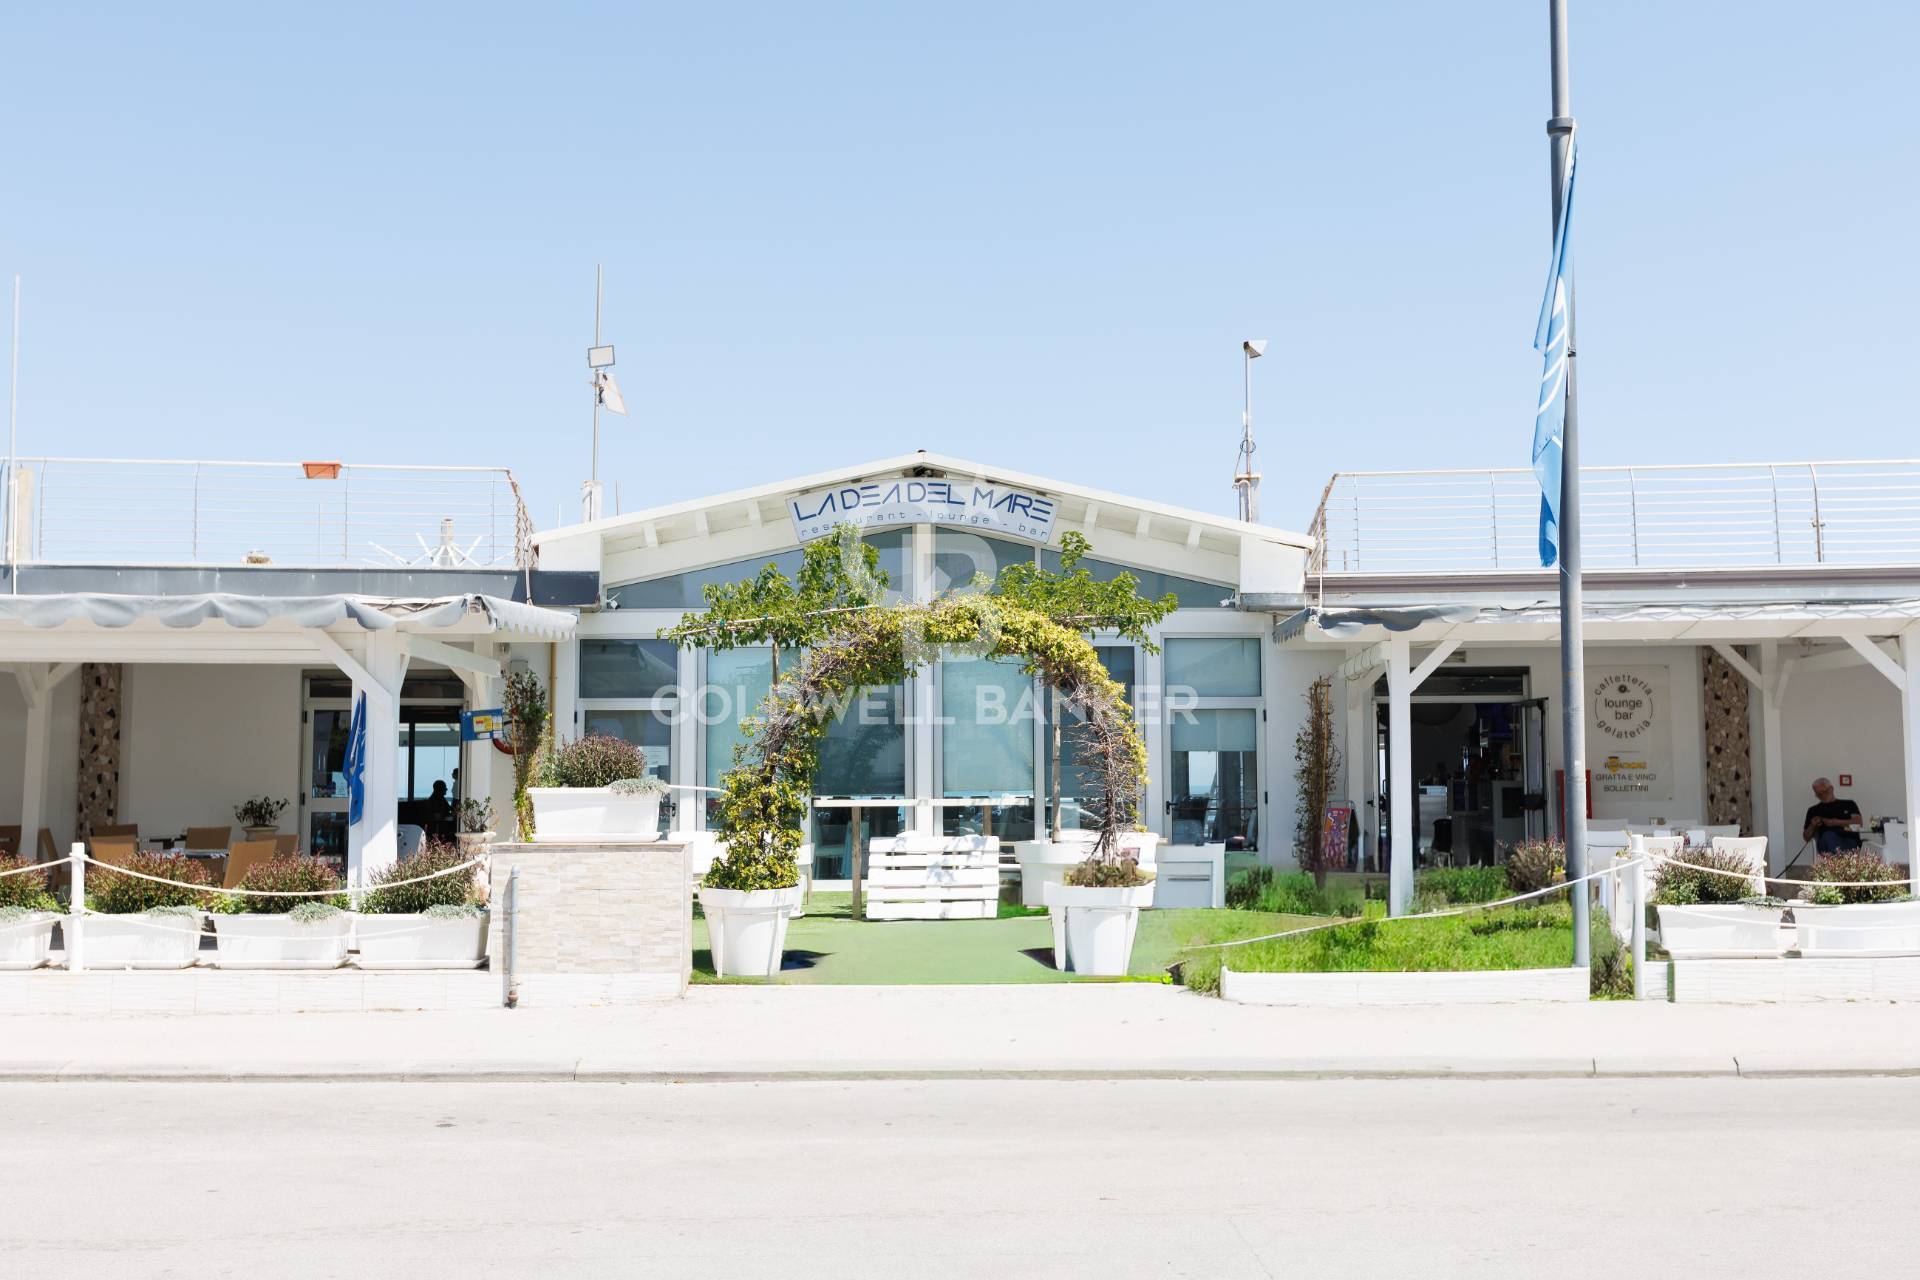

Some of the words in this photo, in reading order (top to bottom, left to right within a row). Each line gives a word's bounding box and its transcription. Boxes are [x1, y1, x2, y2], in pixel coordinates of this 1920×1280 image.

[793, 492, 836, 521] LA
[840, 483, 900, 510] DEA
[907, 482, 965, 506] DEL
[973, 486, 1054, 523] MARE
[930, 509, 990, 525] lounge
[1018, 524, 1048, 537] bar
[1594, 674, 1653, 697] caffetteria
[1604, 697, 1643, 711] lounge
[1614, 709, 1634, 721] bar
[1596, 719, 1651, 740] gelateria
[1603, 784, 1649, 792] BOLLETTINI
